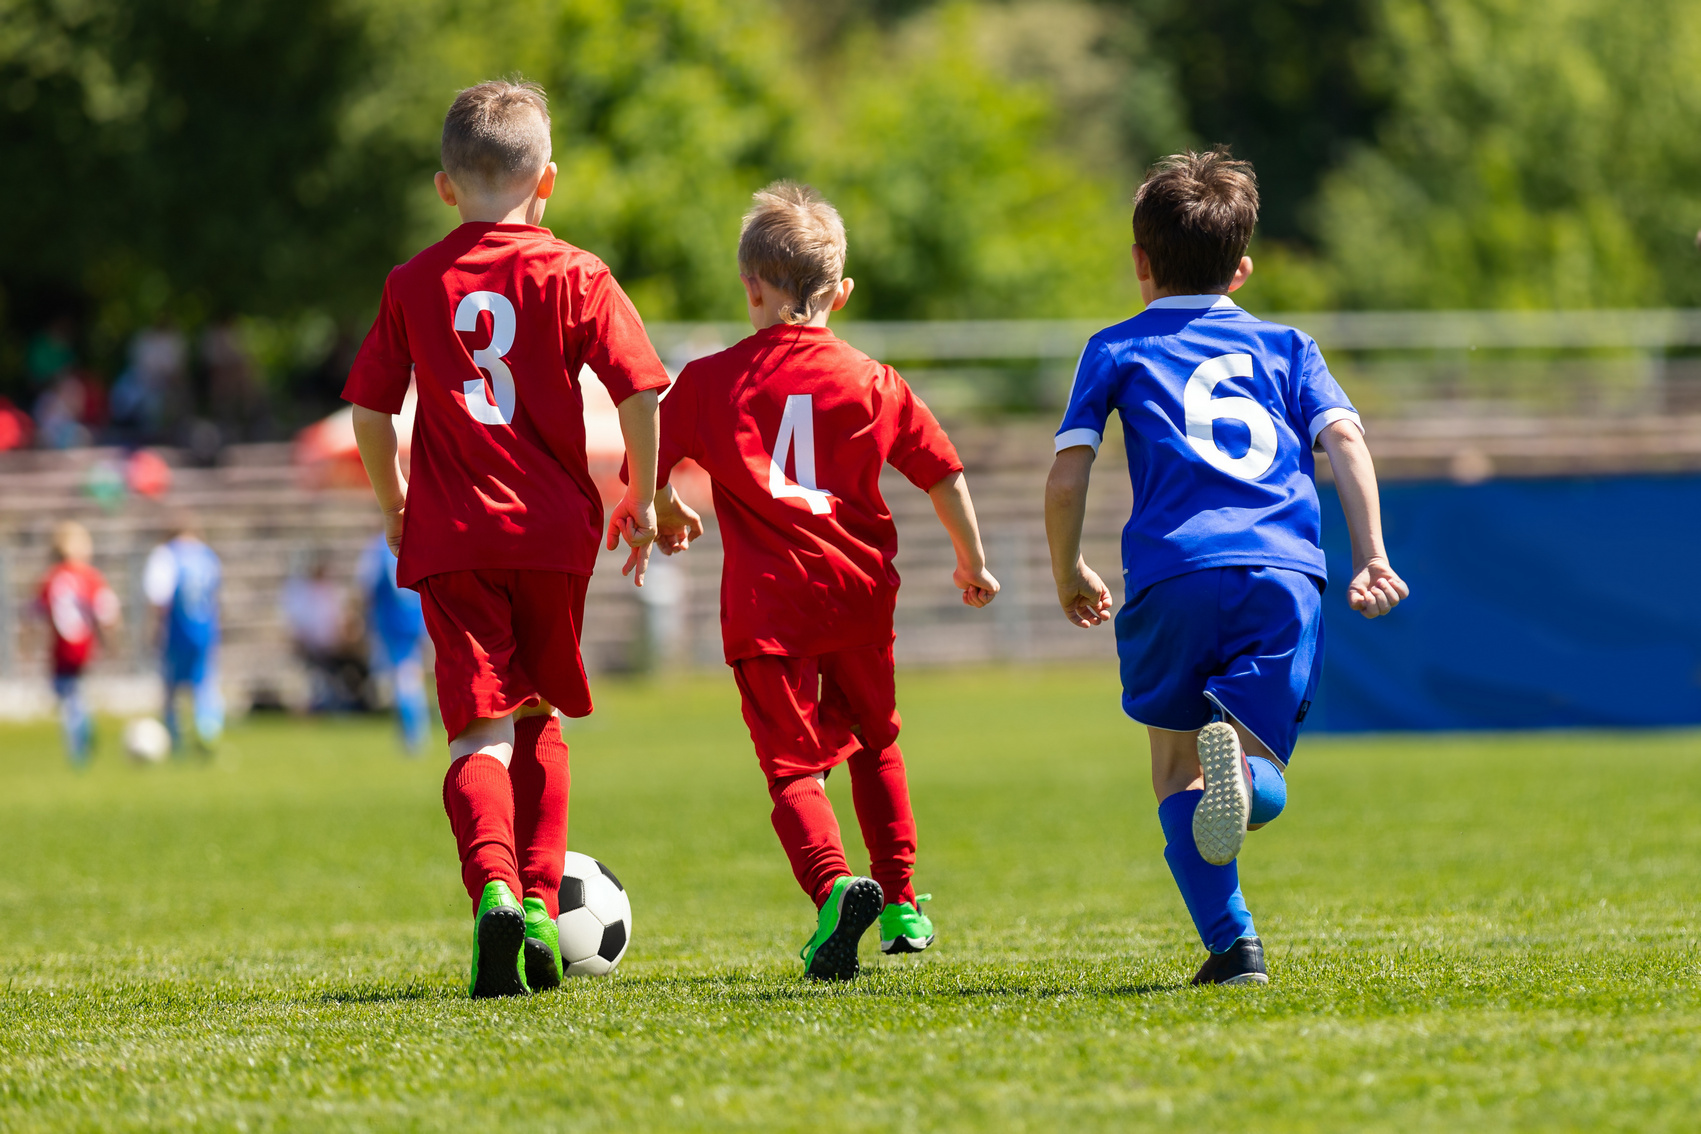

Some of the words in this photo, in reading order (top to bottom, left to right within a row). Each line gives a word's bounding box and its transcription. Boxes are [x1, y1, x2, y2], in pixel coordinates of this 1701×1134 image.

[454, 291, 516, 425] 3
[1184, 353, 1278, 480] 6
[769, 394, 832, 515] 4
